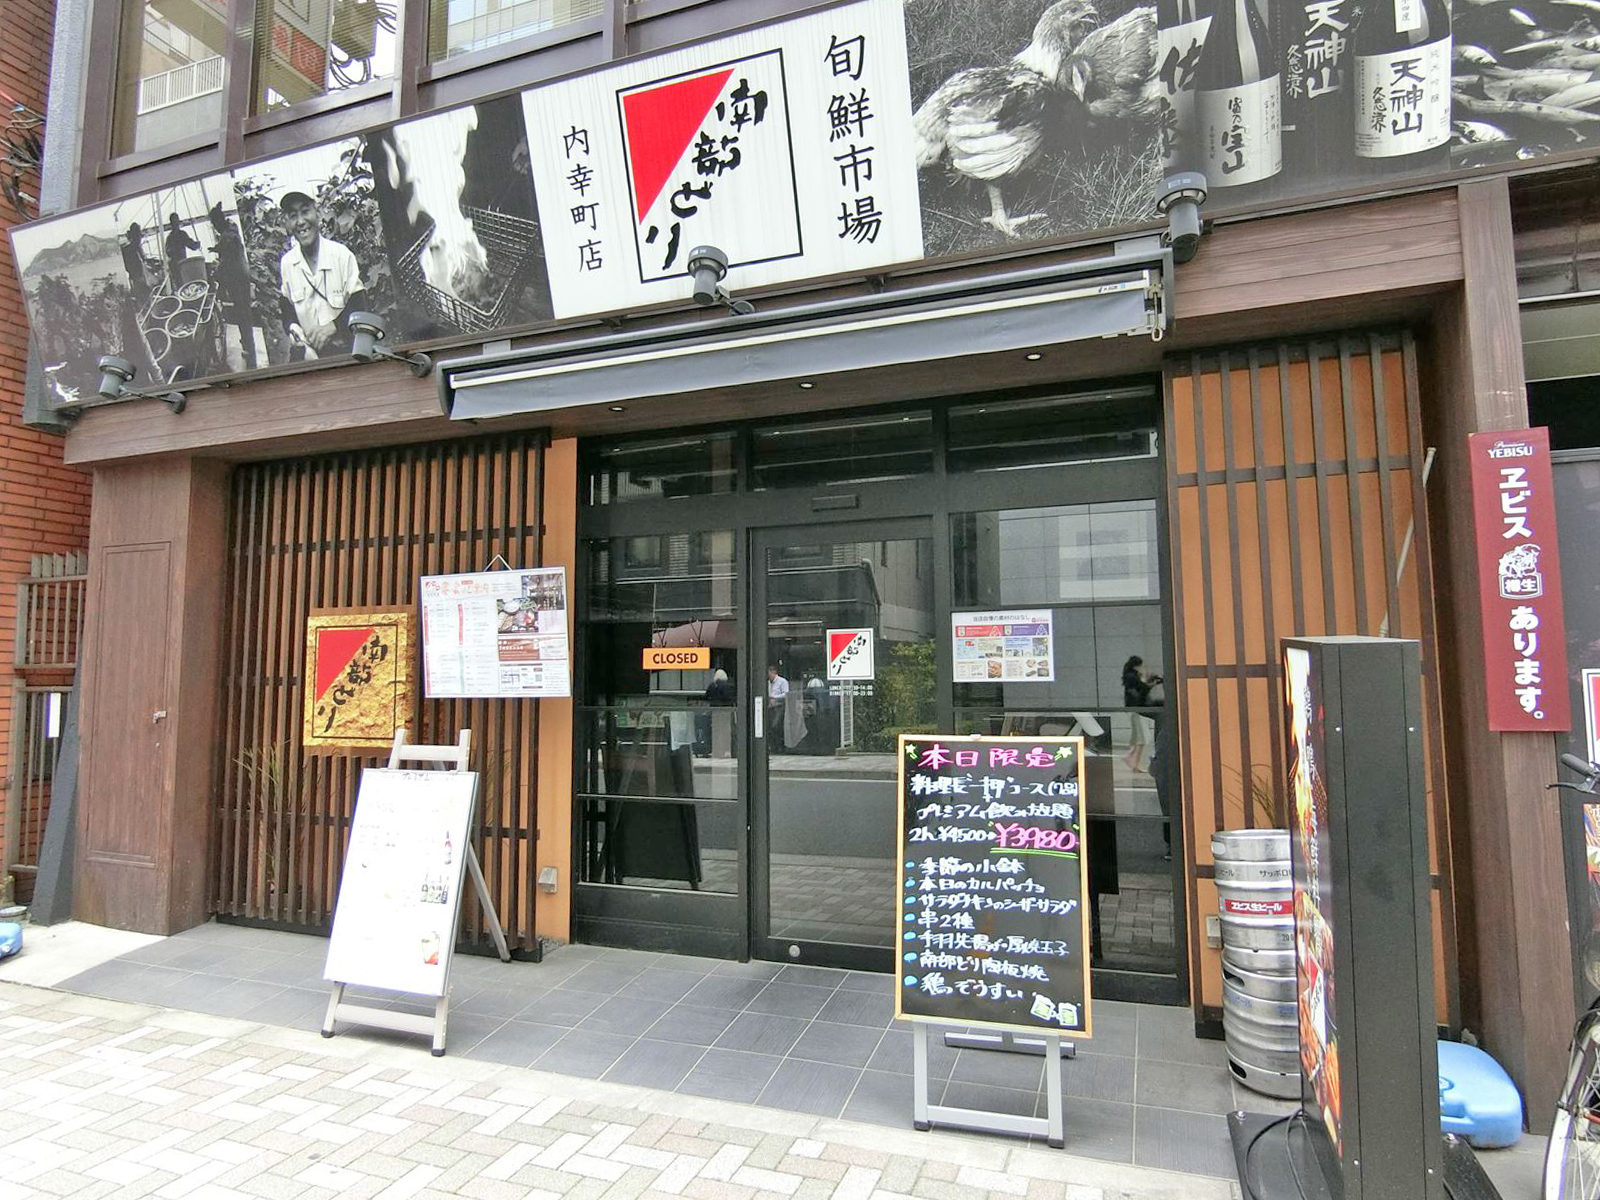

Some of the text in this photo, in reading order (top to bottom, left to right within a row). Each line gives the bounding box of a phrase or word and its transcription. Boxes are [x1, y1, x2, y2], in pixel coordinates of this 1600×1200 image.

[1304, 0, 1349, 99] 天神山
[1389, 57, 1426, 136] 天神山
[823, 34, 883, 245] 旬鮮市場
[562, 125, 603, 274] 内幸町店
[645, 78, 768, 270] 南部どり
[1487, 445, 1533, 459] YEBISU
[317, 634, 389, 733] 南部どり
[653, 652, 698, 664] CLOSED
[1508, 605, 1545, 720] あります。
[917, 743, 1056, 770] 本日限定
[916, 802, 1074, 820] プレミアム飲み放題
[918, 875, 1046, 893] 本日のカルパッチョ
[1259, 869, 1290, 877] サッポロ
[918, 907, 975, 929] 串2種
